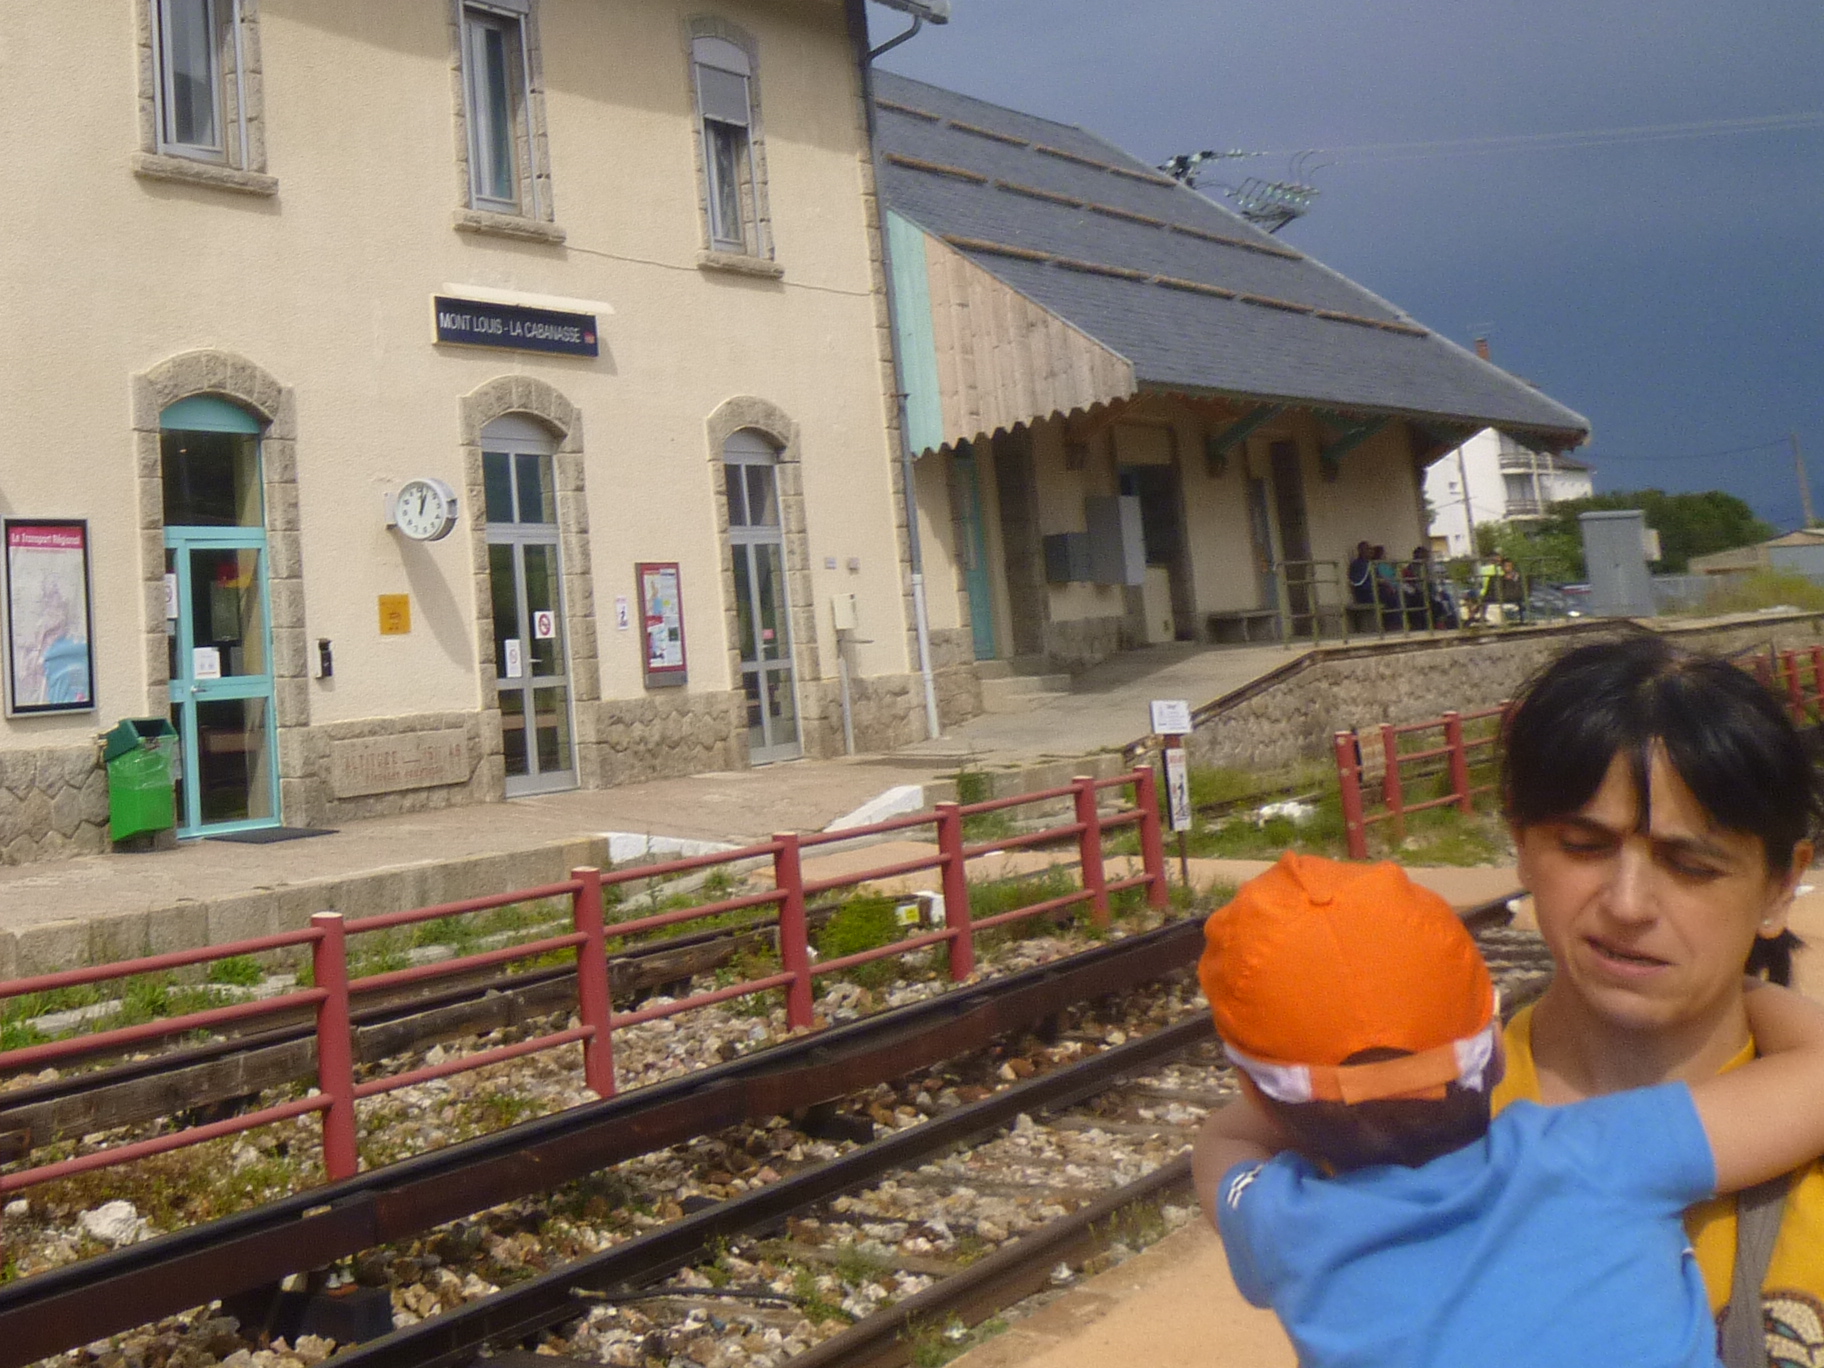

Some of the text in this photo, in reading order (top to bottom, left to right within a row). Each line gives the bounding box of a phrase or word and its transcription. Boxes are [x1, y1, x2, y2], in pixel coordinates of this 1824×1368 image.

[439, 312, 472, 330] MONT
[473, 315, 503, 334] LOUIS
[509, 321, 524, 337] LA
[525, 322, 581, 343] CABANASSE
